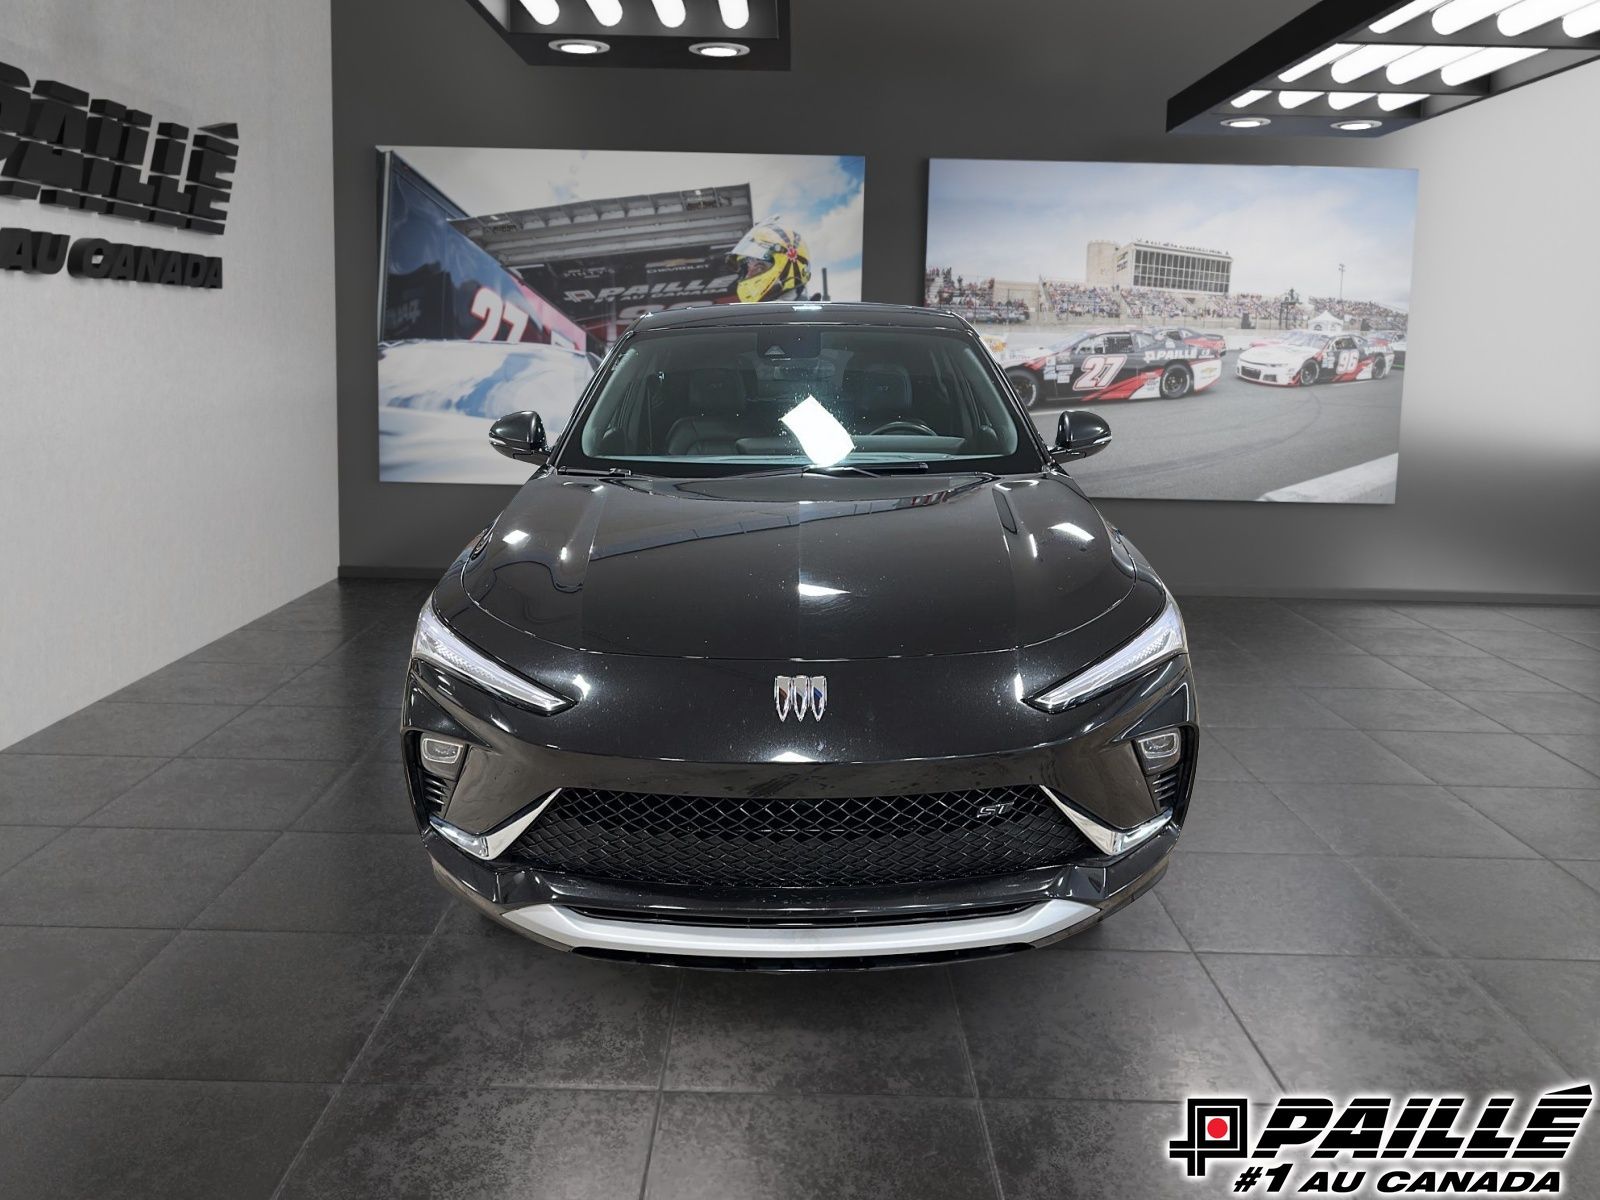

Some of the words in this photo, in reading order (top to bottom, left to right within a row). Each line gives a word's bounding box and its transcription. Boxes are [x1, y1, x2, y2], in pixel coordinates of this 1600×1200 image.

[0, 227, 71, 274] AU
[67, 237, 223, 289] CANADA
[647, 263, 710, 274] CHEVROLET
[650, 287, 728, 299] CANADA
[469, 285, 529, 344] 27
[1072, 354, 1128, 391] 27
[1336, 347, 1360, 375] 96
